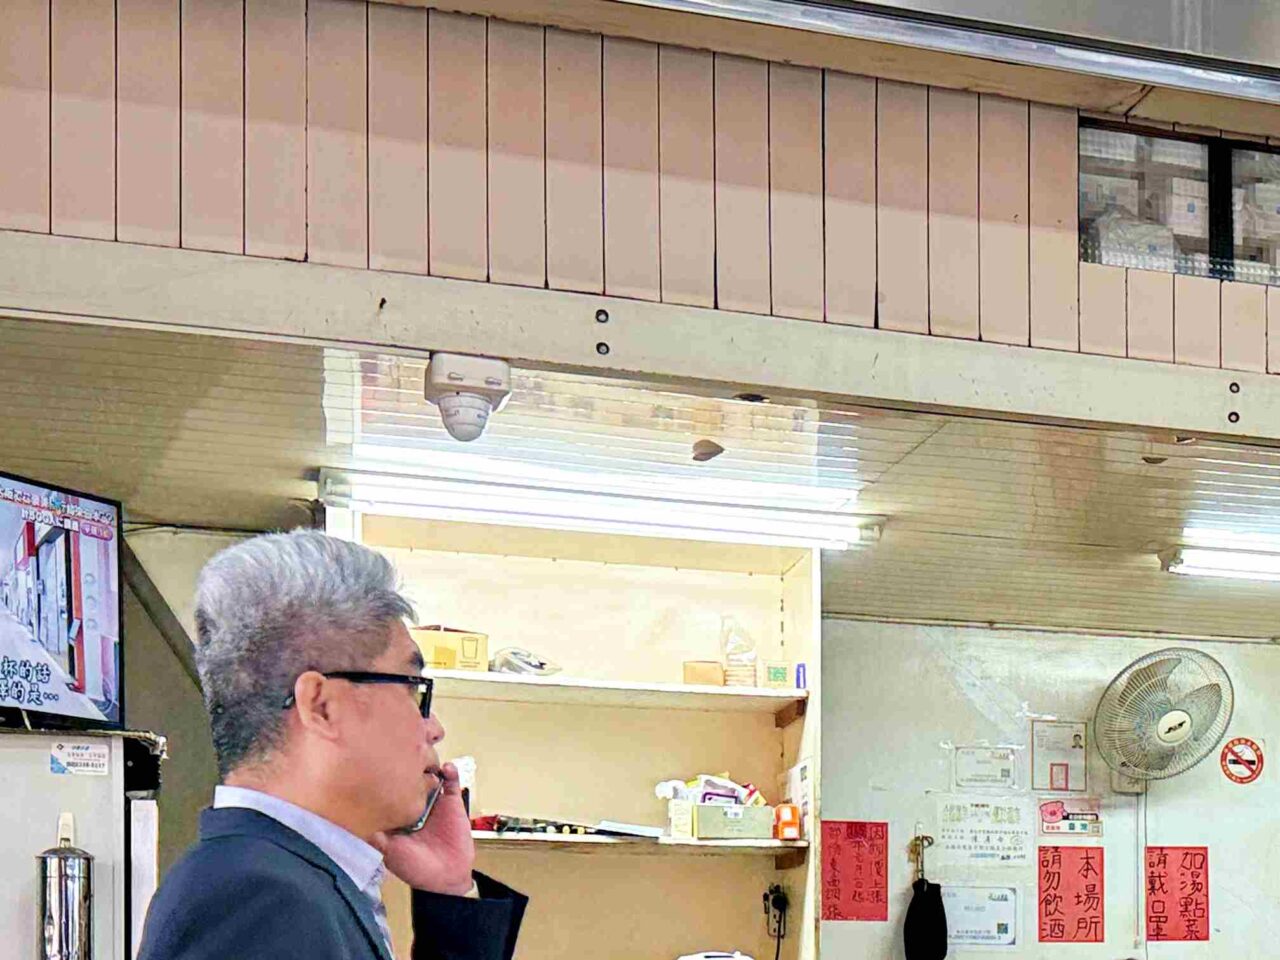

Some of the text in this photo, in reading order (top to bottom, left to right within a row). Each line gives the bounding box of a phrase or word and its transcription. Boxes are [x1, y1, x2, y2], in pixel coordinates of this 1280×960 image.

[1040, 847, 1065, 939] 請勿飲酒
[1073, 850, 1100, 941] 本場所
[1149, 848, 1169, 941] 請戴口罩
[1178, 852, 1207, 940] 加湯點菜
